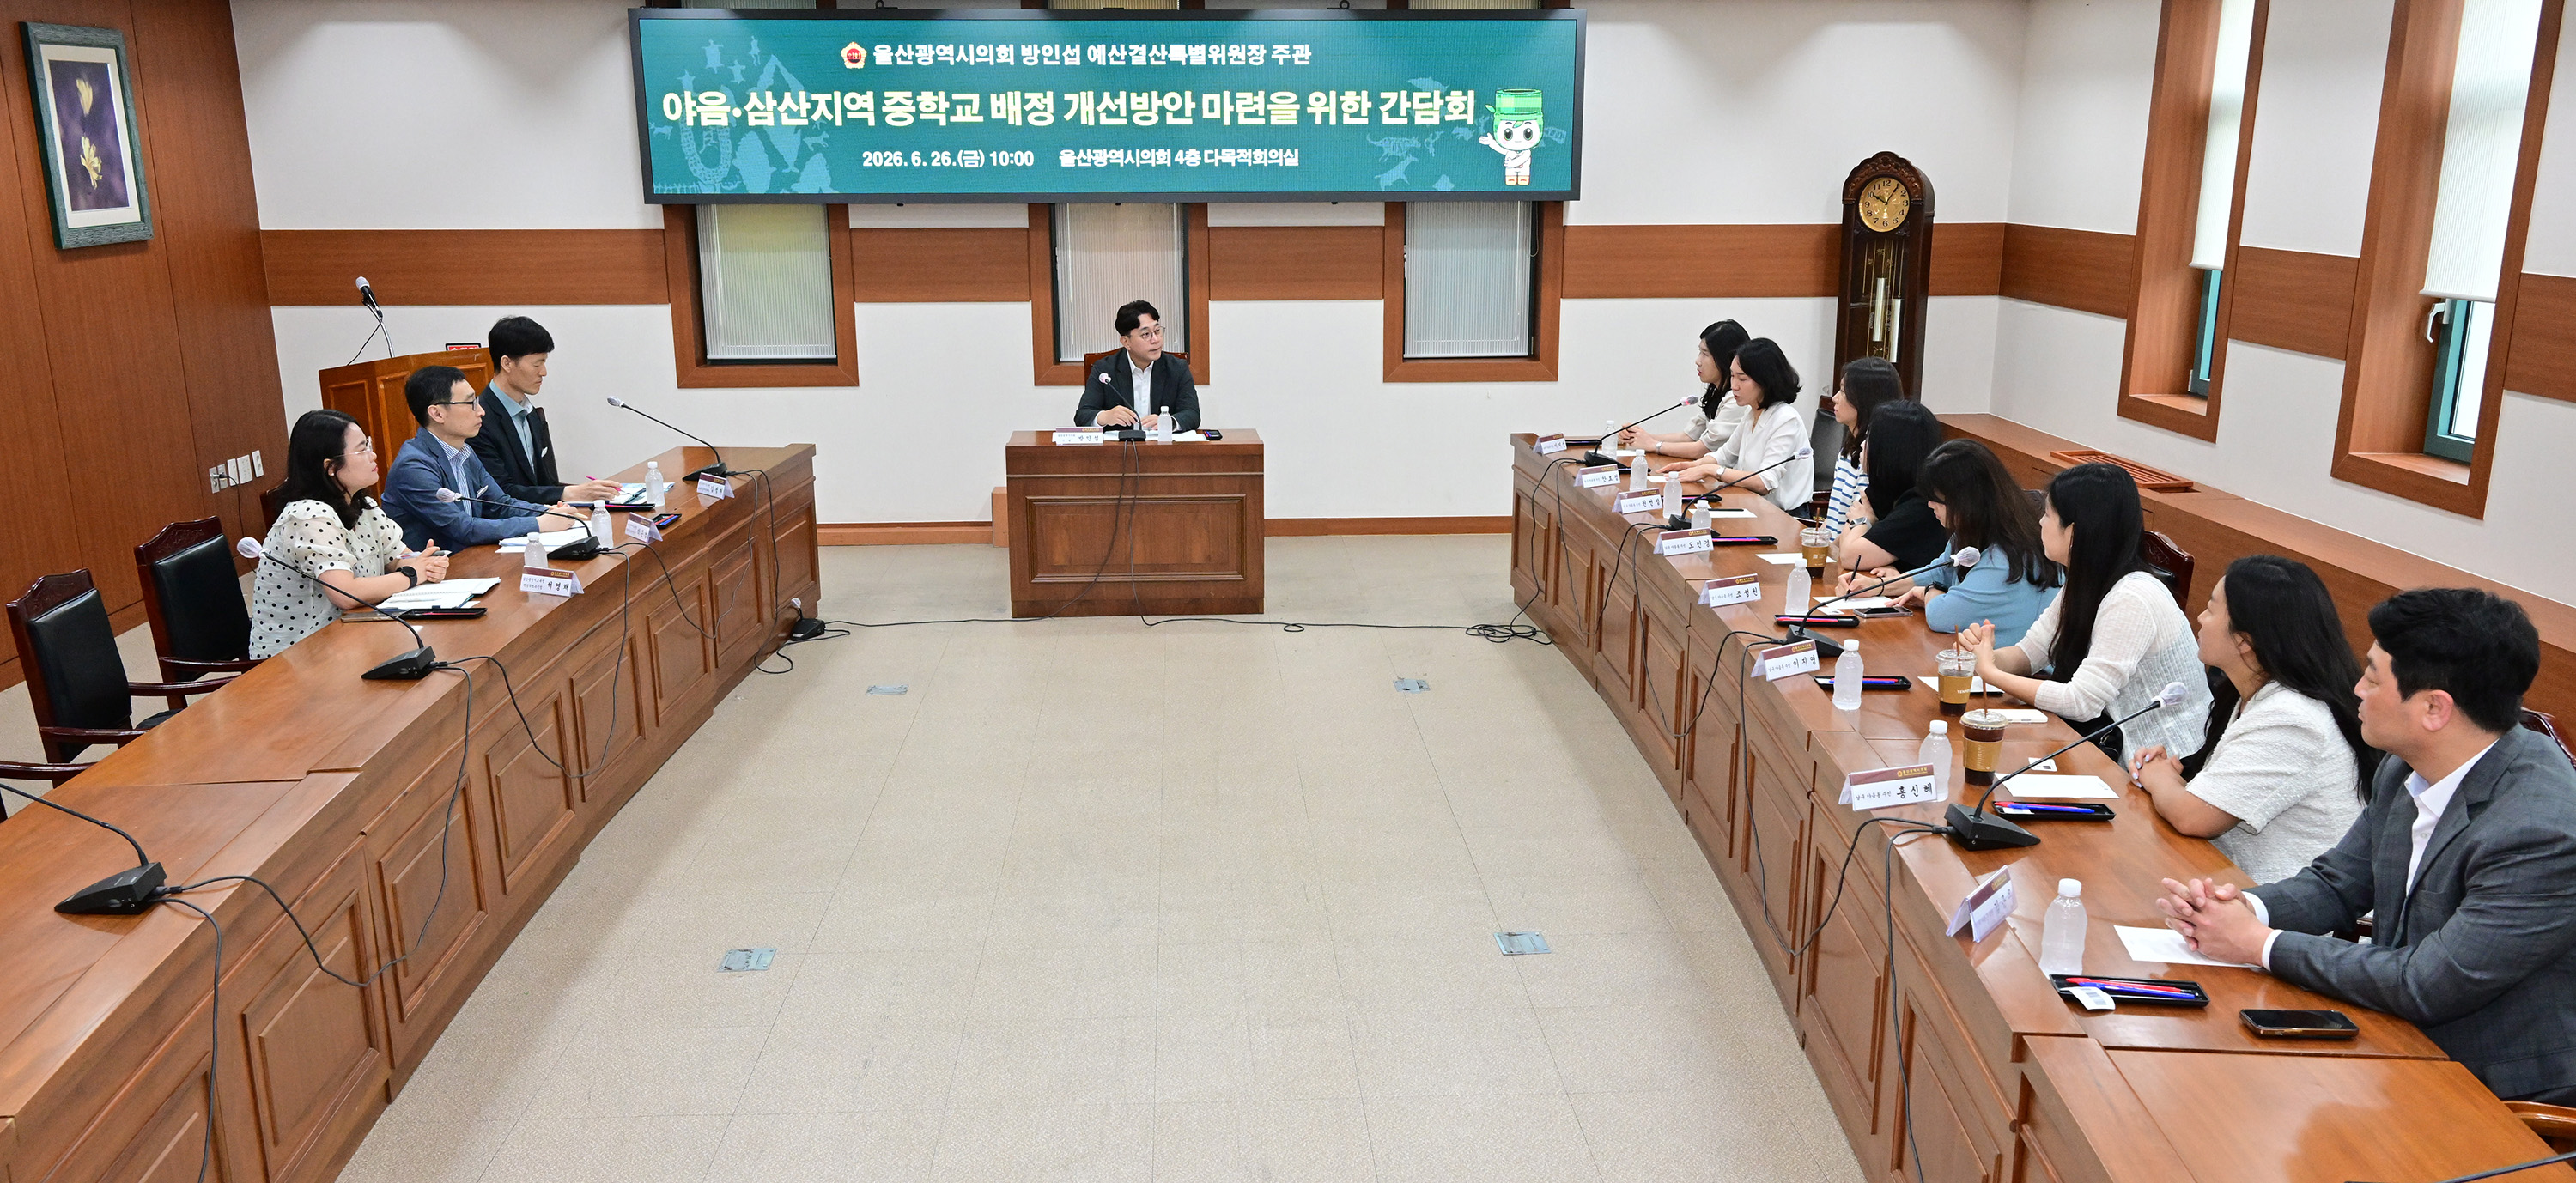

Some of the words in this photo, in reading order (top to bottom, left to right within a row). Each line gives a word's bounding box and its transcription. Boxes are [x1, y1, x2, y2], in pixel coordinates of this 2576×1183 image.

[873, 45, 1015, 65] 울산광역시의회
[1021, 45, 1081, 65] 방인섭
[1087, 45, 1267, 65] 예산결산특별위원장
[1271, 45, 1312, 65] 주관
[663, 91, 875, 126] 야음·삼산지역
[882, 91, 984, 126] 중학교
[990, 91, 1054, 126] 배정
[1063, 90, 1196, 126] 개선방안
[1202, 90, 1301, 125] 마련을
[1306, 90, 1372, 125] 위한
[1379, 90, 1475, 125] 간담회
[862, 151, 908, 167] 2026.
[911, 151, 927, 167] 6.
[931, 150, 985, 168] 26.(금)
[989, 151, 1035, 167] 10:00
[1059, 149, 1172, 167] 울산광역시의회
[1174, 149, 1202, 167] 4층
[1203, 149, 1300, 167] 다목적회의실
[1896, 782, 1933, 799] 홍신혜
